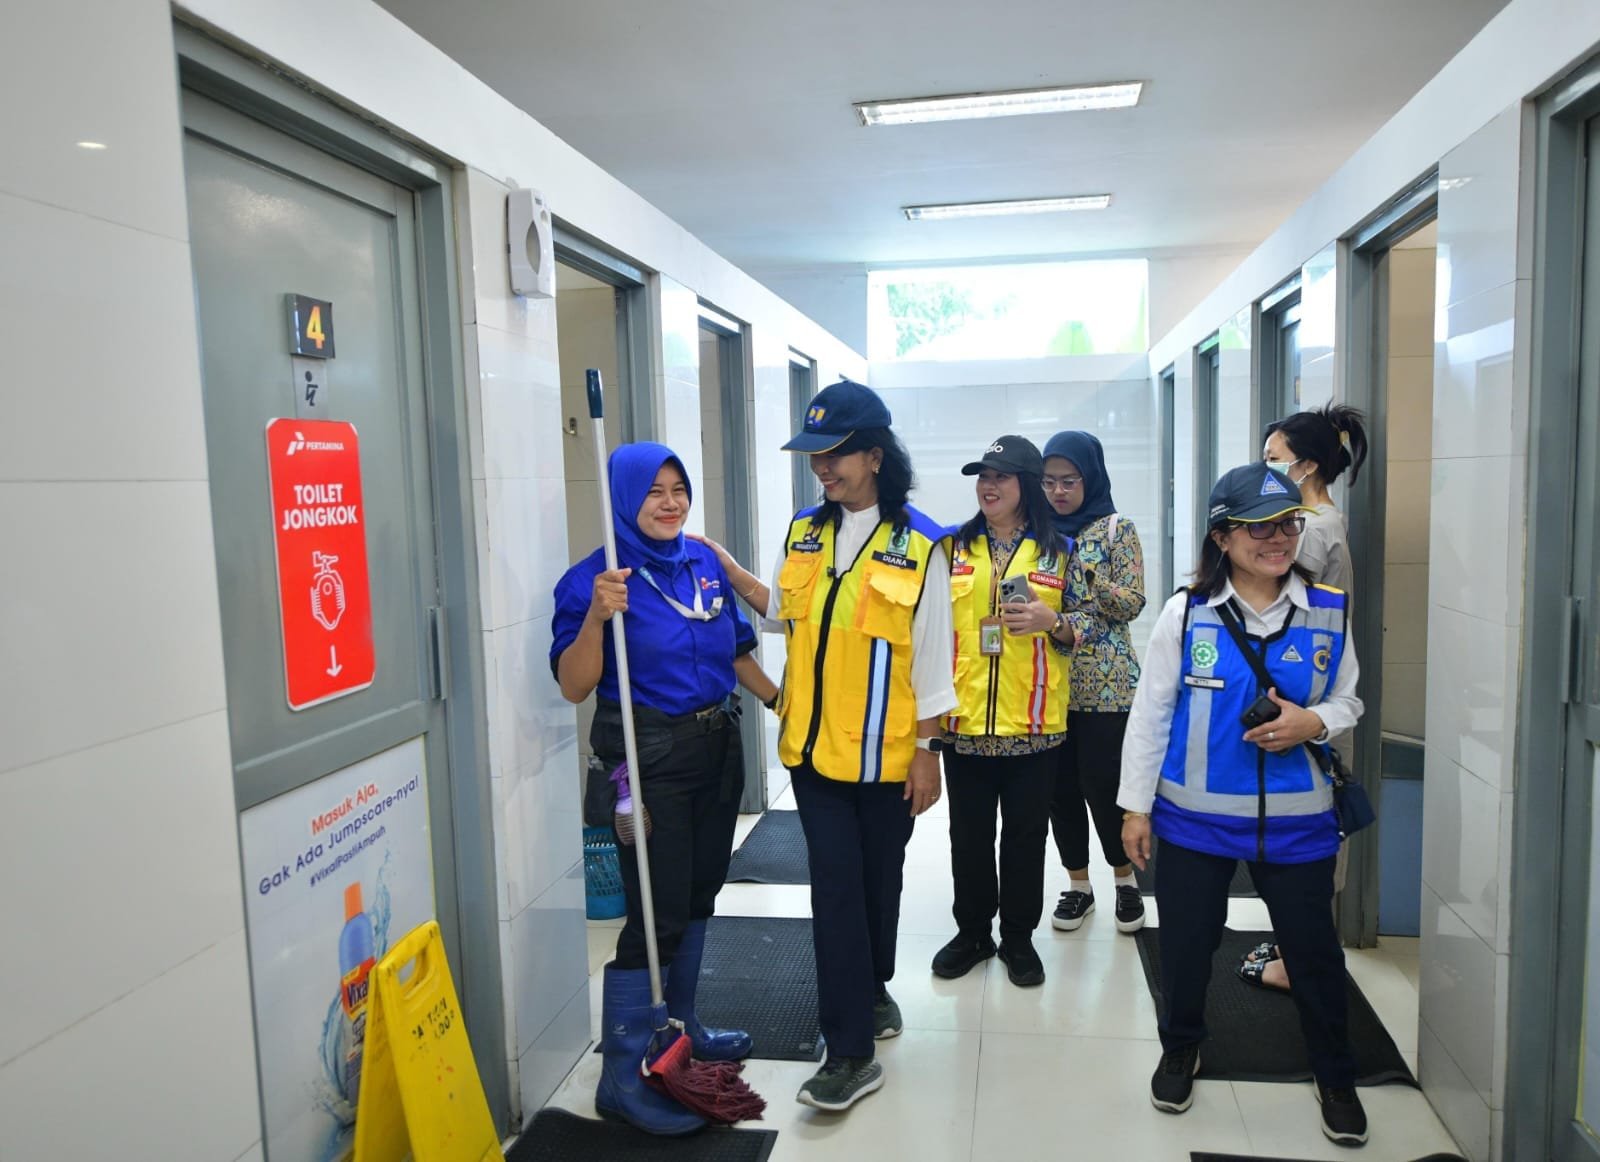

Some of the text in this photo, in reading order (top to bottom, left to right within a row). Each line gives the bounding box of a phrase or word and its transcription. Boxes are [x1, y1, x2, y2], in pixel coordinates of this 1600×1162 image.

[306, 305, 325, 349] 4
[306, 441, 345, 451] PERTAMINA
[293, 483, 343, 505] TOILET
[281, 505, 358, 530] JONGKOK
[882, 554, 907, 566] DIANA
[310, 797, 353, 836] Masuk
[258, 774, 419, 896] Gak Ada Jumpscare-nya!
[309, 825, 387, 888] #VixalPastiAmpuh
